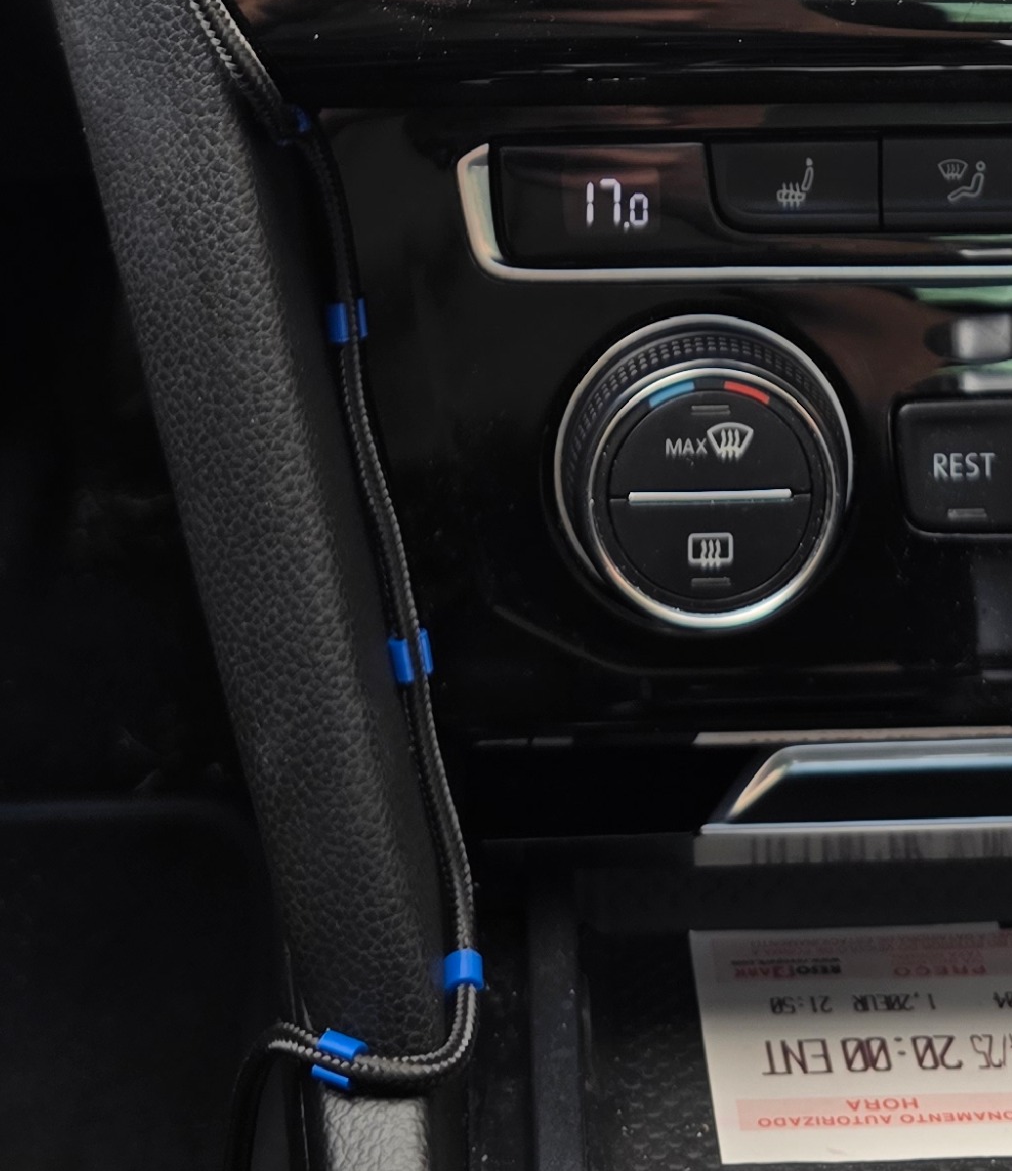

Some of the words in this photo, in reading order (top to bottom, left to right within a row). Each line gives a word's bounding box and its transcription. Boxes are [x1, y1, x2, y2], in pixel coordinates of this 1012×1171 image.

[665, 438, 707, 457] MAX
[933, 452, 996, 479] REST
[770, 996, 833, 1015] 21:50
[763, 1039, 833, 1075] ENT
[842, 1036, 963, 1072] 20:00
[846, 1097, 919, 1110] HORA
[758, 1113, 892, 1128] AUTORIZADO
